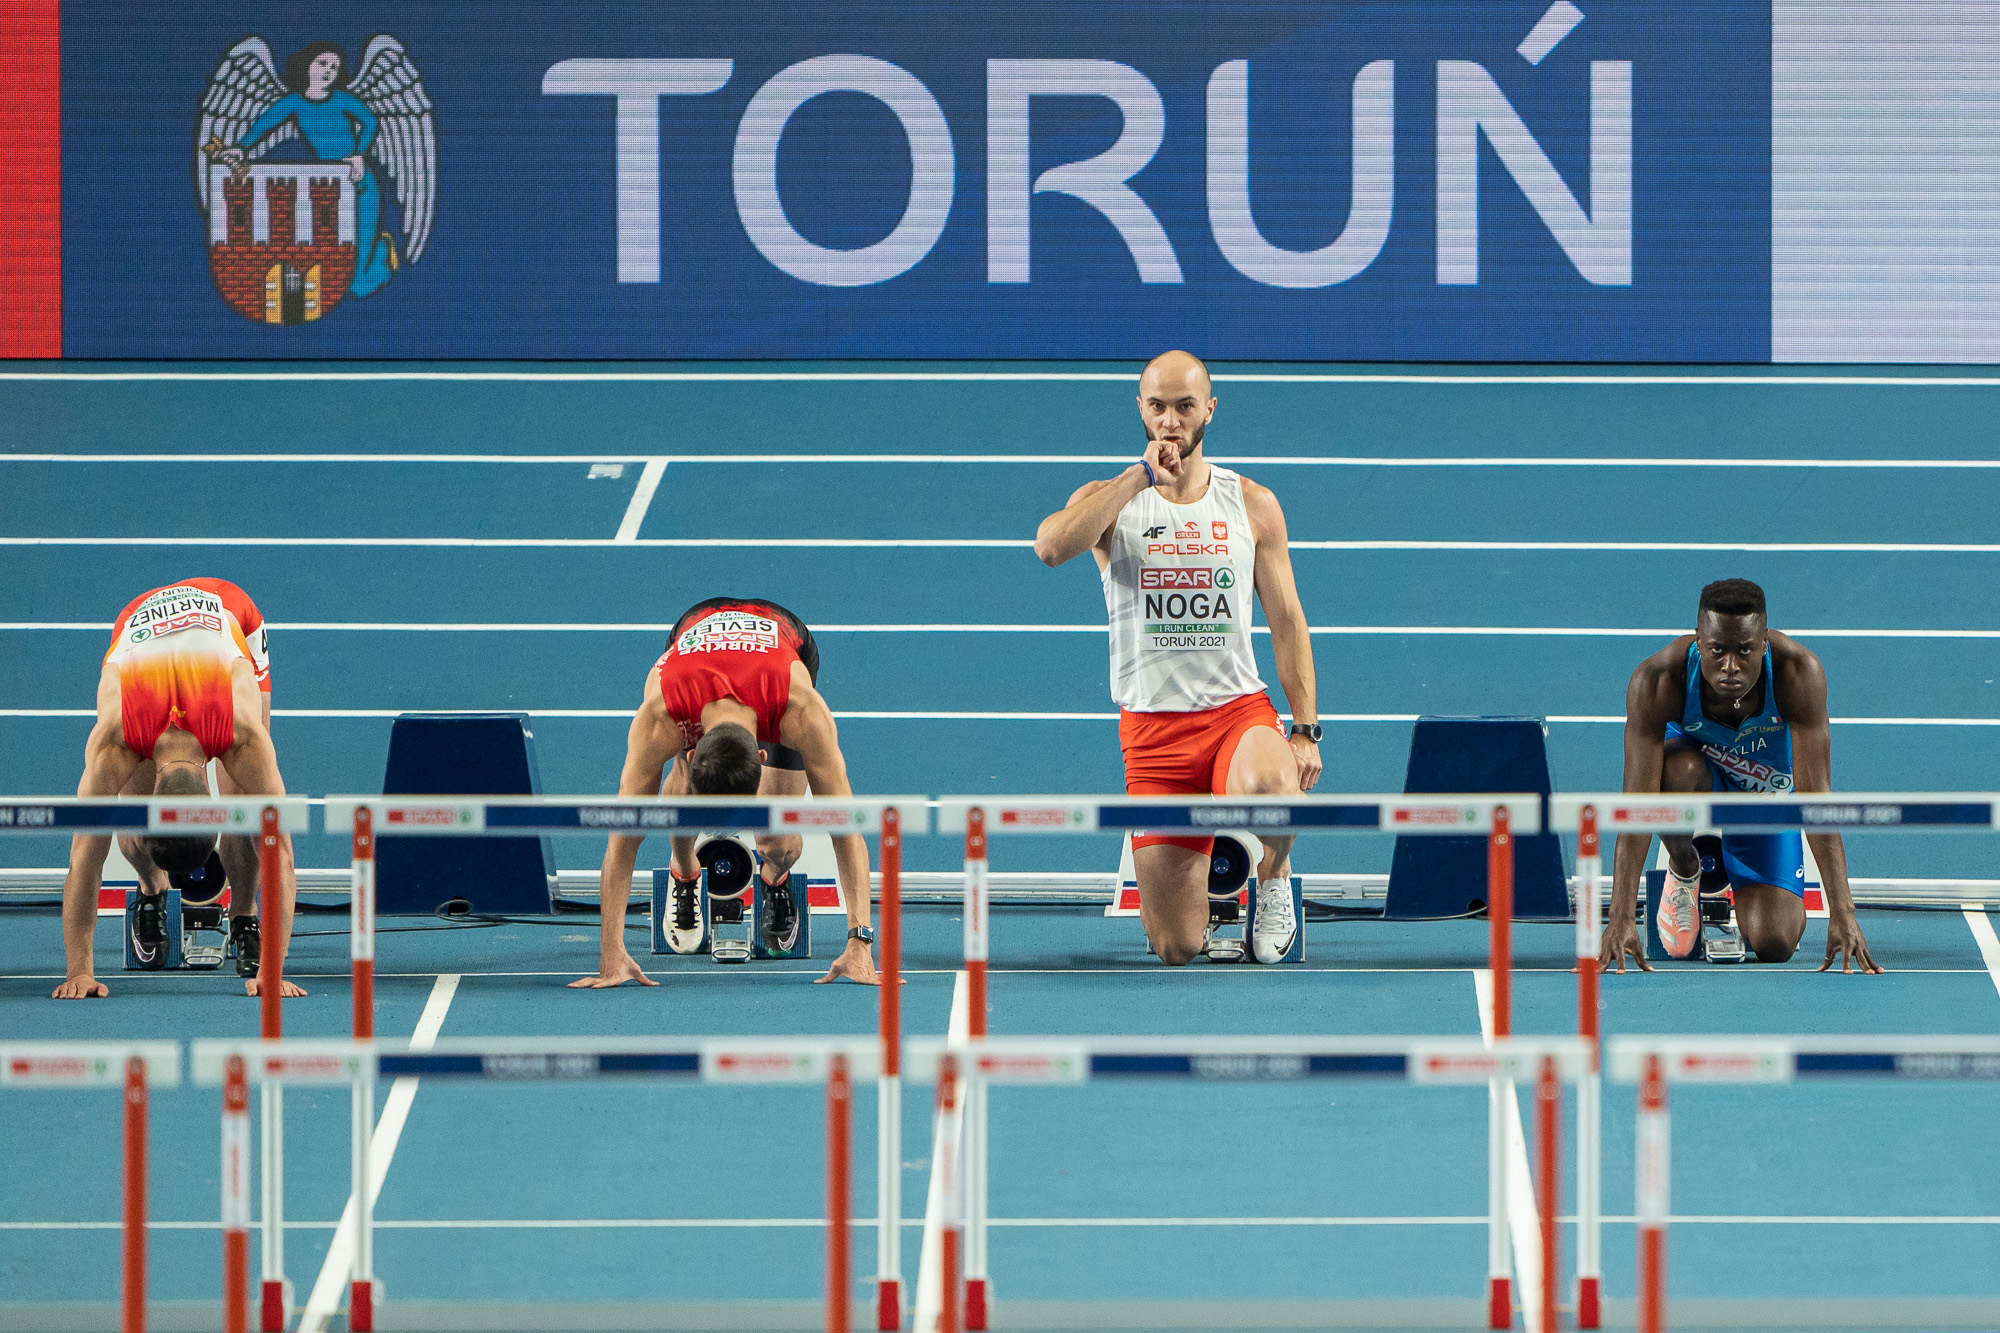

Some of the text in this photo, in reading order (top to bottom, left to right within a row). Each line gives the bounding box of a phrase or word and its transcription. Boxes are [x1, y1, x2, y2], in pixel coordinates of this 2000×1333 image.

[541, 0, 1632, 287] TORUŃ
[1175, 531, 1200, 539] ORLEN
[1147, 543, 1229, 556] POLSKA
[1142, 569, 1211, 588] SPAR
[129, 598, 220, 628] MARTÍNEZ
[1145, 593, 1232, 619] NOGA
[154, 613, 221, 634] SPAR
[684, 620, 773, 639] SEVLER
[1164, 624, 1184, 633] RUN
[705, 631, 775, 646] SPAR
[1152, 635, 1226, 647] TORUŃ 2021
[1705, 746, 1770, 779] SPAR
